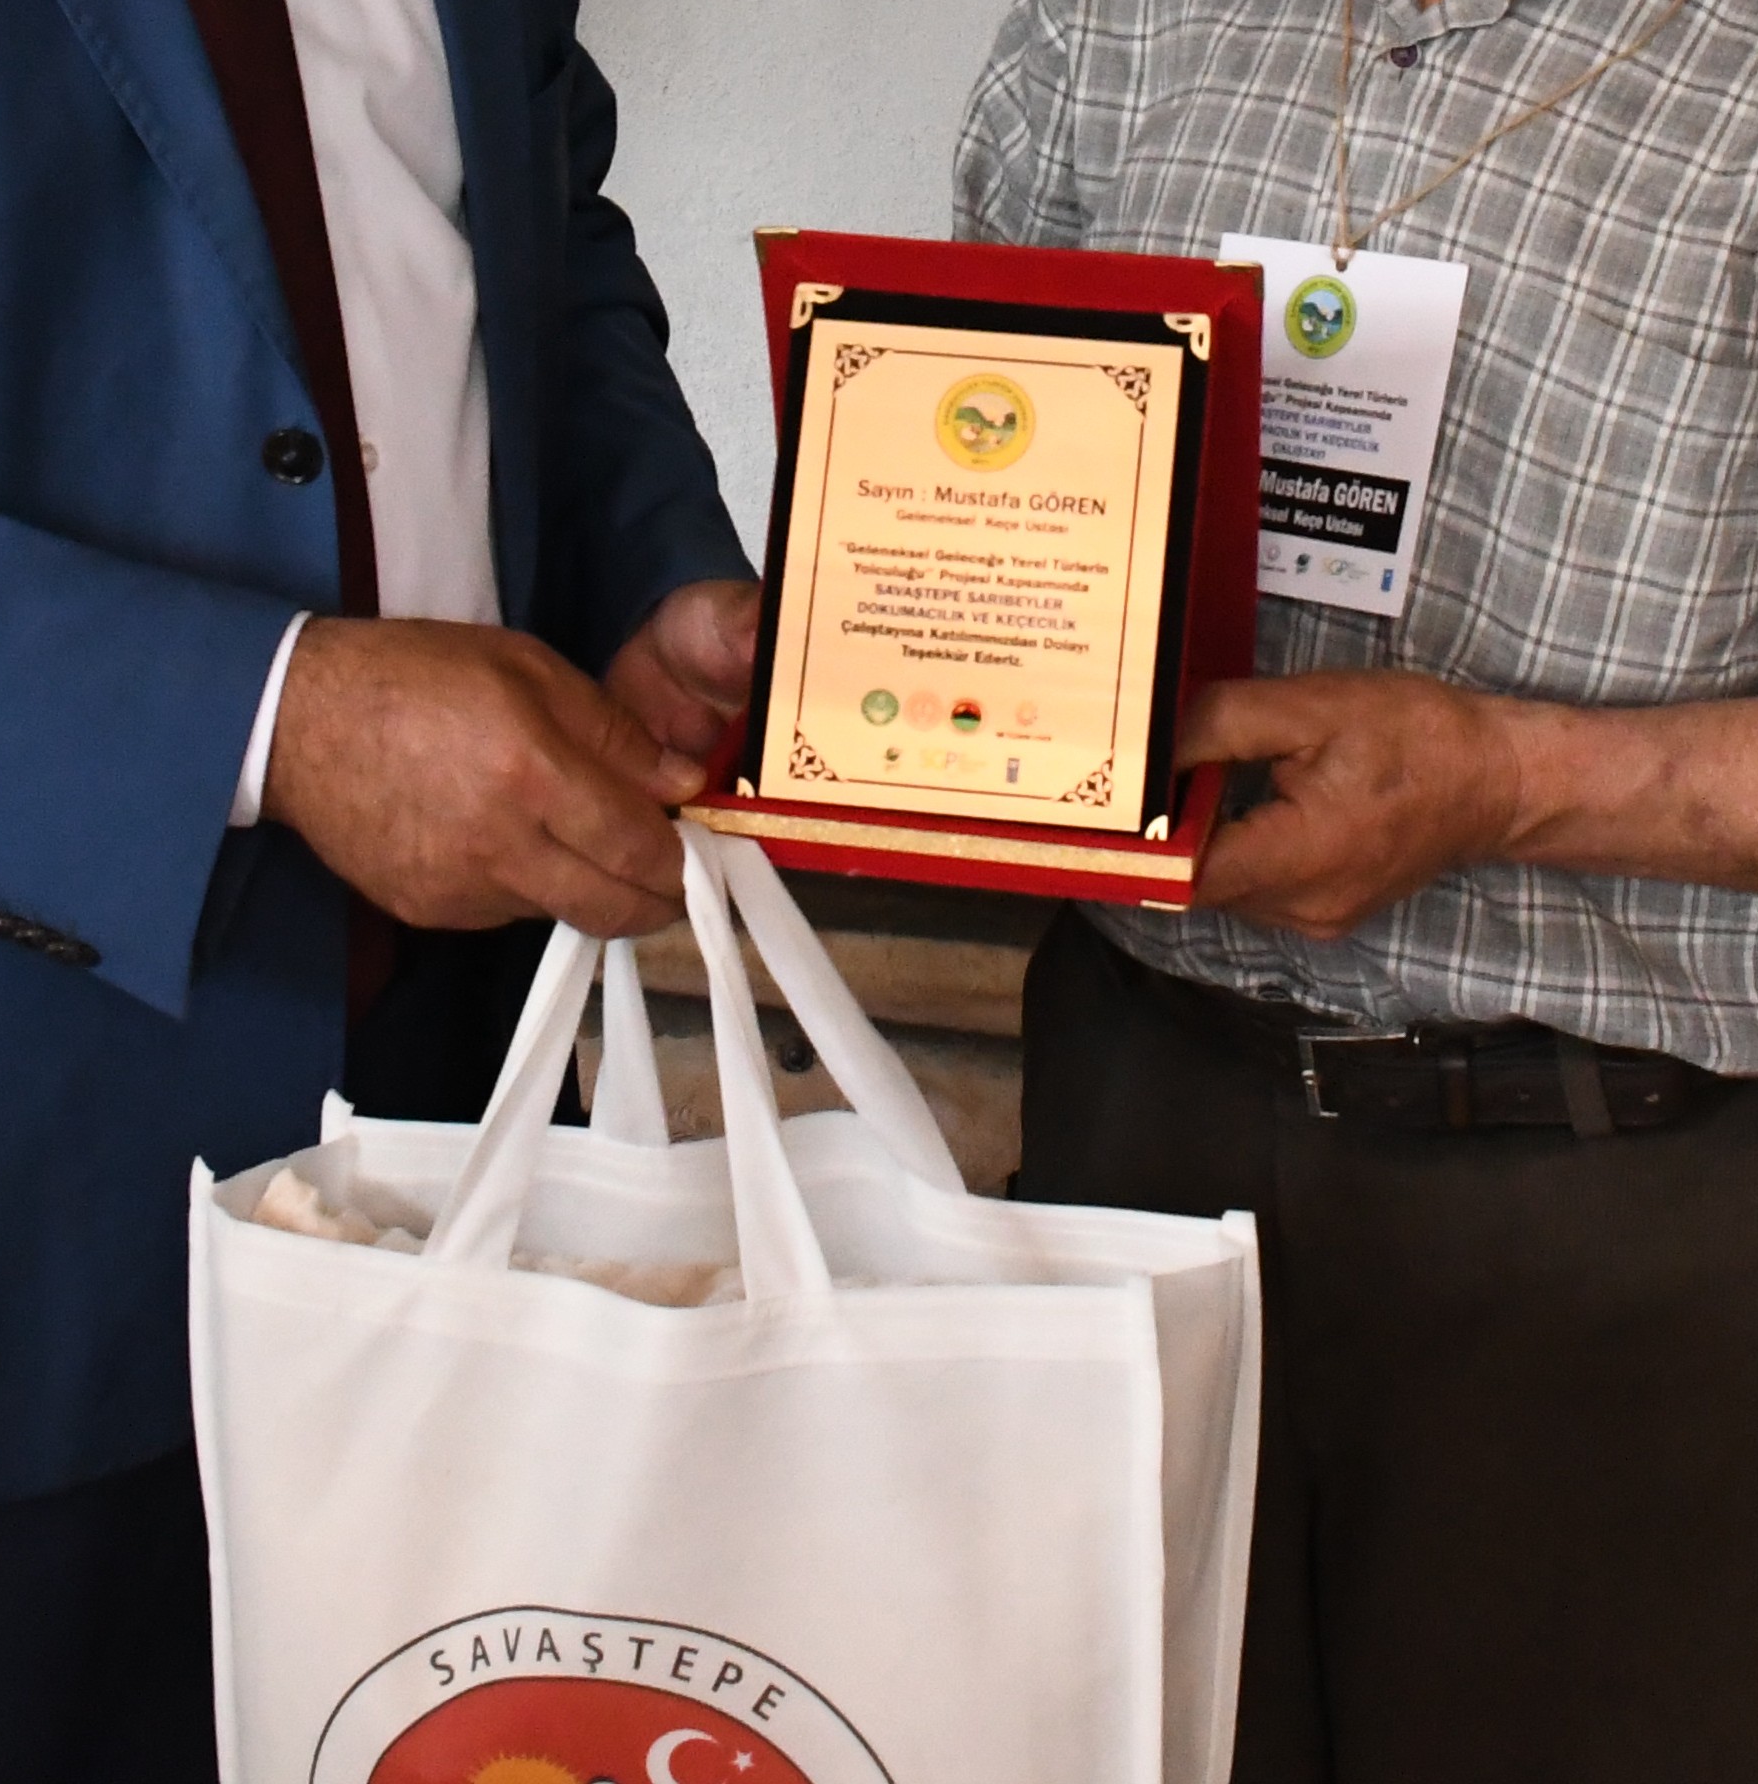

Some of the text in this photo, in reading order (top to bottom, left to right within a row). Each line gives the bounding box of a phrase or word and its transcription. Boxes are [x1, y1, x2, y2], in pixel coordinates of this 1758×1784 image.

[1337, 385, 1364, 399] Yerel
[1305, 431, 1319, 443] VE
[858, 479, 914, 503] Sayın
[934, 486, 1021, 509] Mustafa
[1029, 491, 1107, 516] GÖREN
[1261, 469, 1399, 515] Mustafa GÖREN
[896, 509, 976, 527] Geleneksel
[985, 517, 1018, 532] Keçe
[1293, 508, 1324, 532] Keçe
[935, 549, 1005, 568] Geleceğe
[1011, 556, 1047, 568] Yerel
[1053, 559, 1109, 574] Türlerin
[939, 568, 990, 585] Projesi
[996, 575, 1089, 592] Kapsamında
[875, 582, 1063, 609] SAVAŞTEPE SARIBEYLER
[857, 601, 1076, 630] DOKUMACILIK VE KEÇECİLİK
[901, 643, 969, 662] Teşekkür
[1043, 637, 1090, 655] Dolayı
[430, 1626, 786, 1722] SAVAŞTEPE
